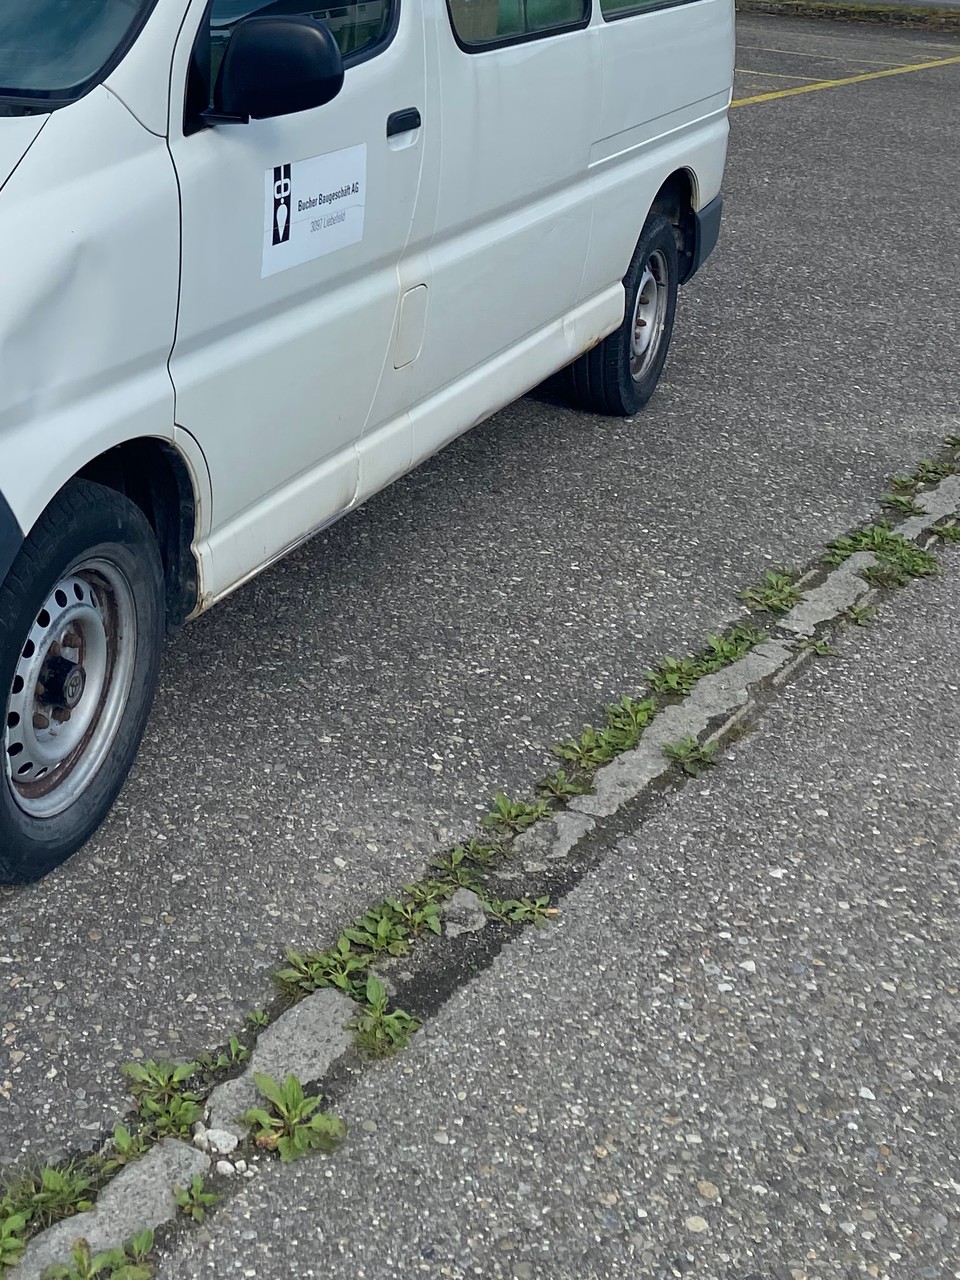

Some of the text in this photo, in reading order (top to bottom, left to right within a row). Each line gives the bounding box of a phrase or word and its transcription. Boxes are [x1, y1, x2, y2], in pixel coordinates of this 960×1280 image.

[297, 181, 359, 212] Bucher Baugeschäft AG
[310, 211, 346, 233] 3097 Liebefeld
